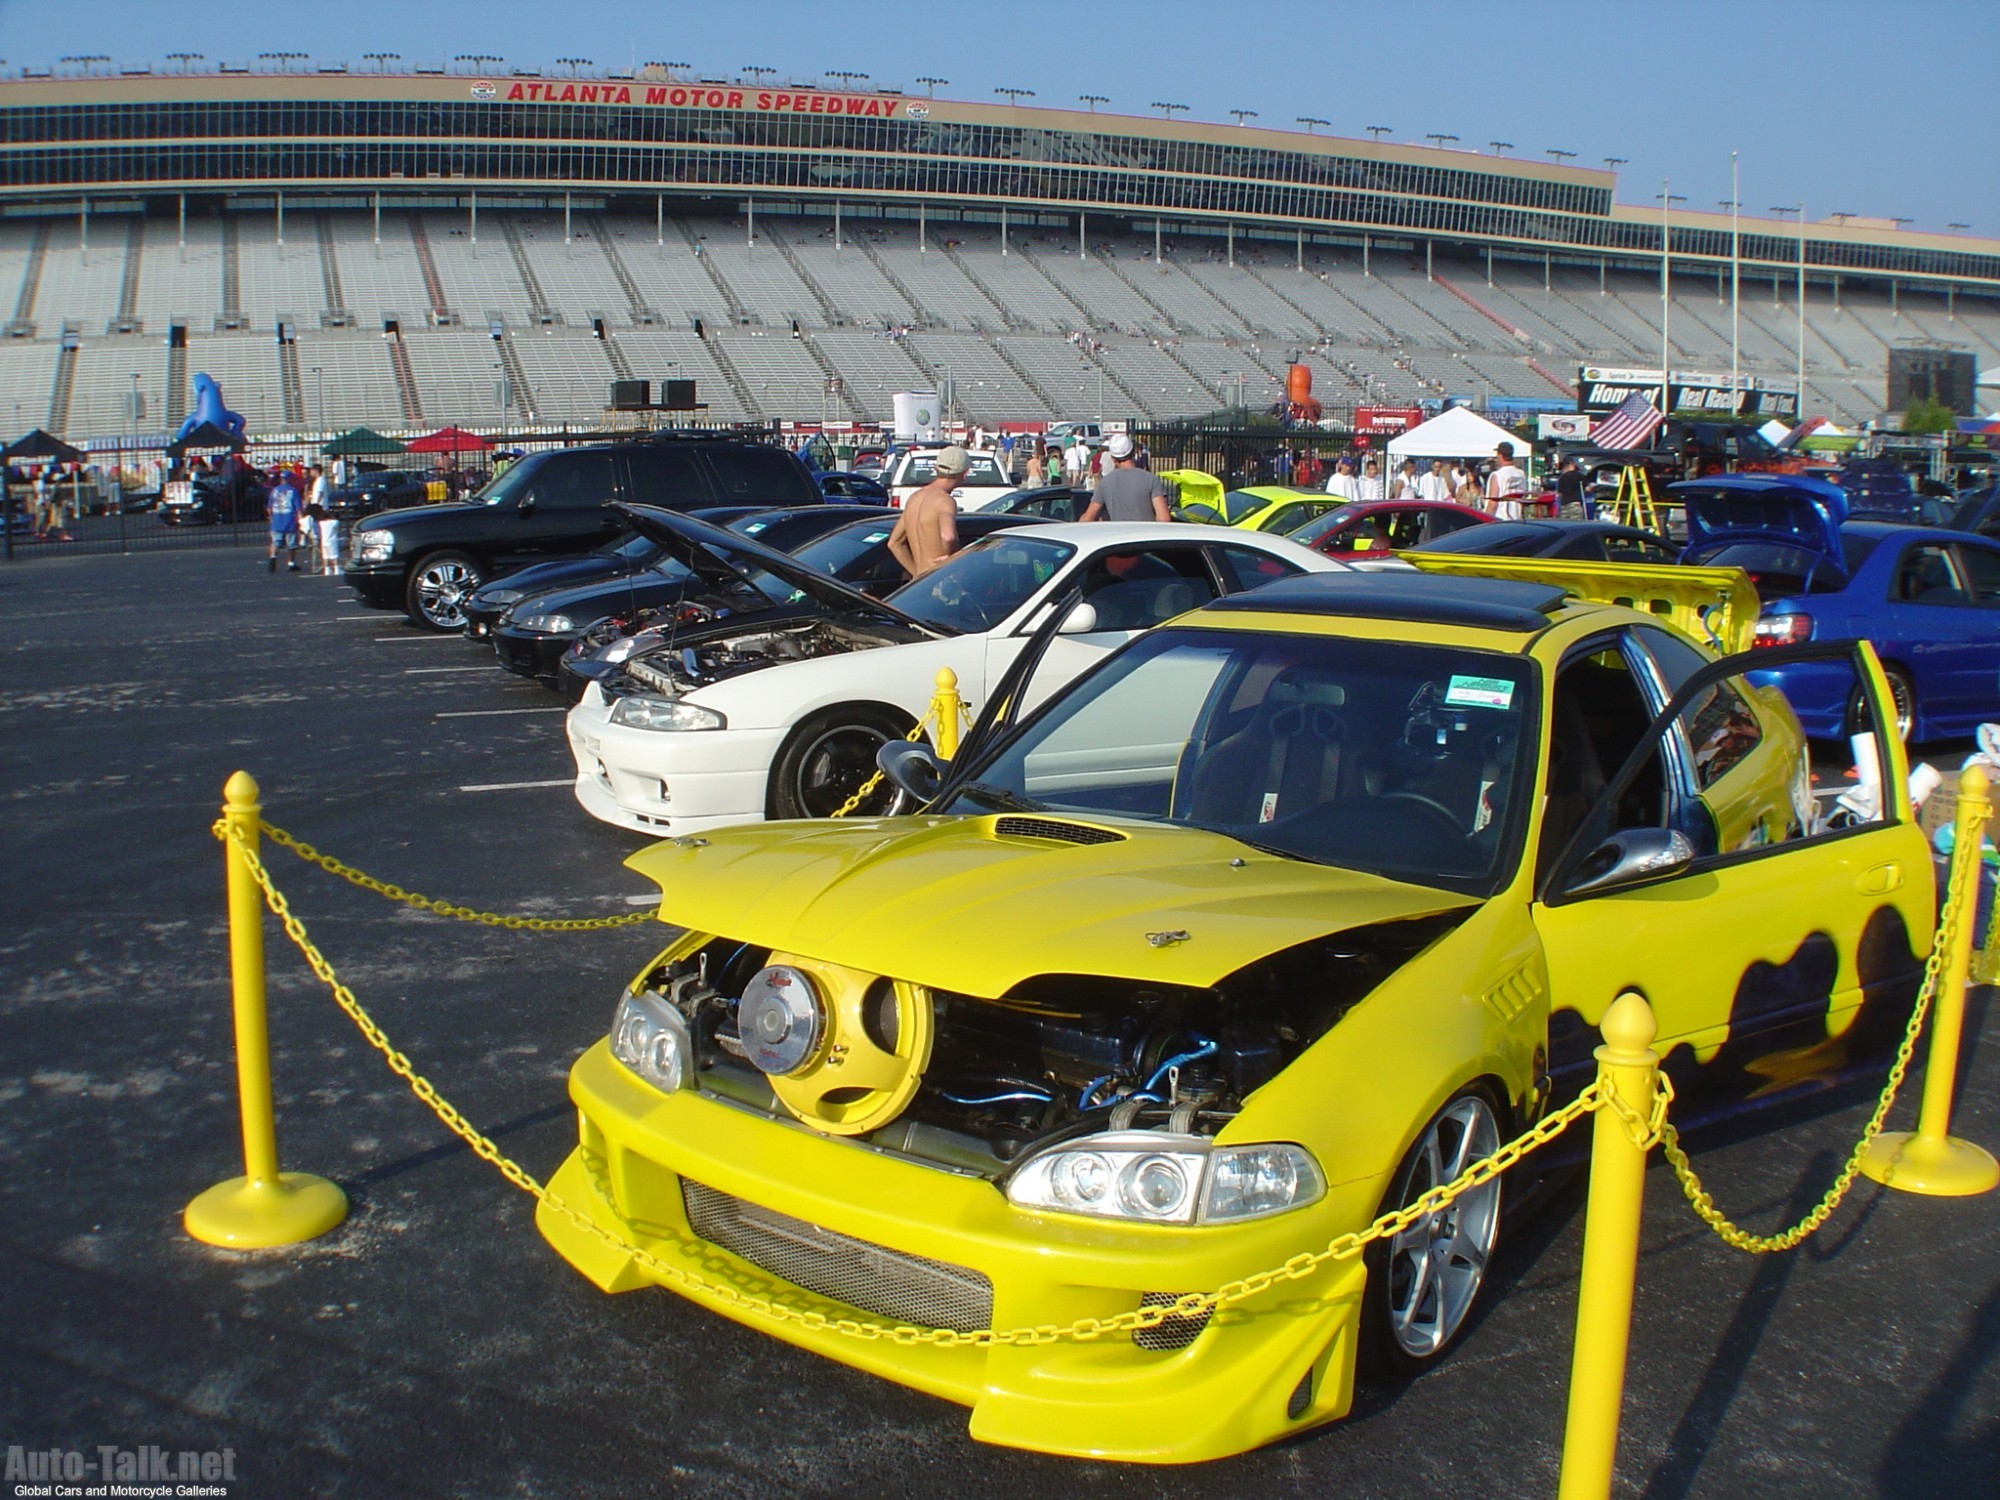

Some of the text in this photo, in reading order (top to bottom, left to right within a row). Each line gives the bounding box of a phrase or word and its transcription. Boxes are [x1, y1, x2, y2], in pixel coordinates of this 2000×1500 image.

[507, 83, 632, 104] ATLANTA
[645, 87, 744, 109] MOTOR
[757, 93, 898, 117] SPEEDWAY
[1679, 387, 1707, 408] Real
